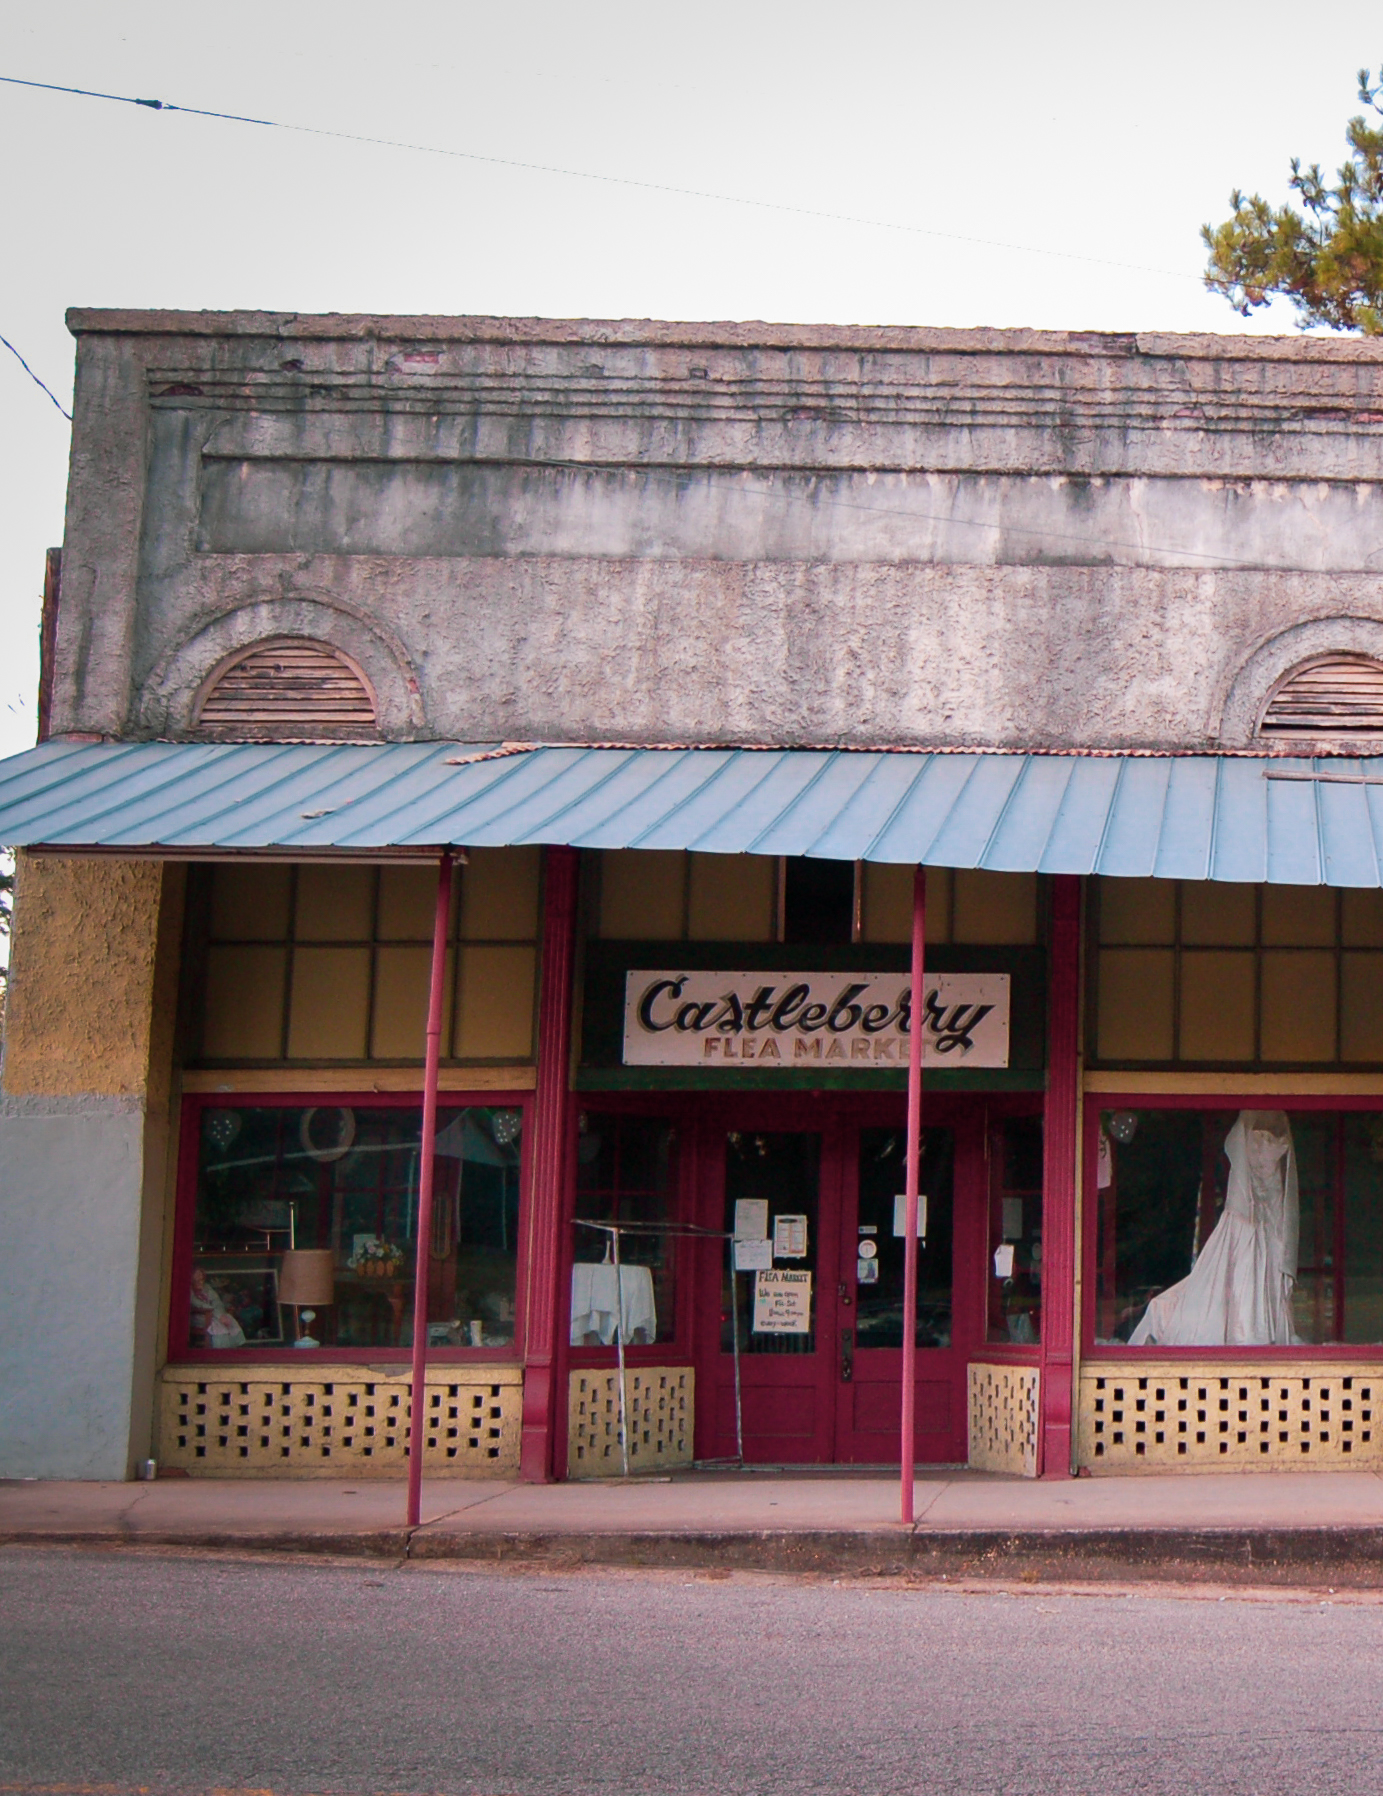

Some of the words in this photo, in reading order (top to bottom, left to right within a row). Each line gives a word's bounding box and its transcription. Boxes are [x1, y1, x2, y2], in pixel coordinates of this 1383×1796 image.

[637, 975, 996, 1057] Castleberry
[703, 1037, 781, 1059] FLEA
[759, 1271, 779, 1283] FLEA
